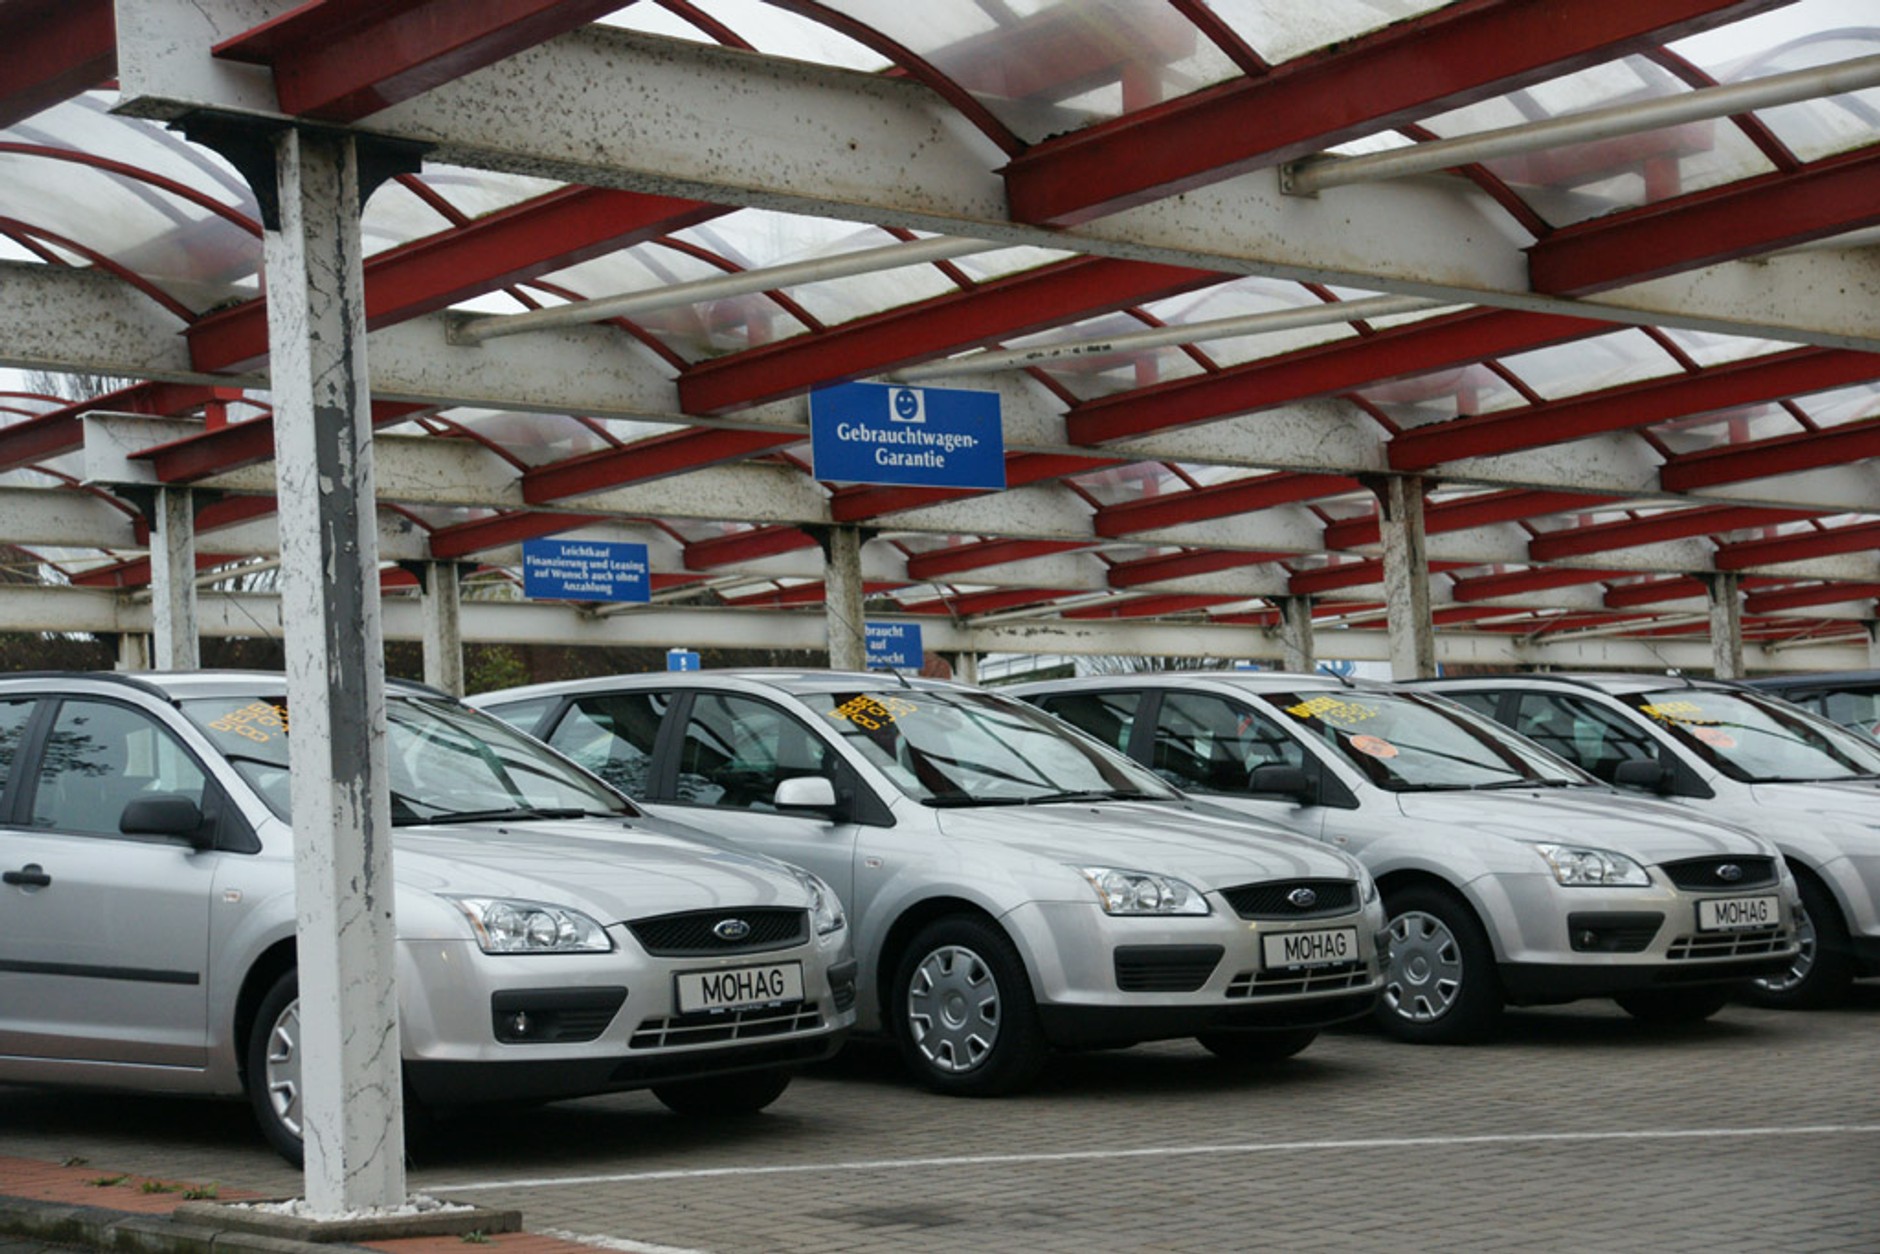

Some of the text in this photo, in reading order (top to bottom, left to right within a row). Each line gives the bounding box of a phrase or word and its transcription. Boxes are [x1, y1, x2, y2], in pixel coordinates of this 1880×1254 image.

[837, 422, 979, 453] Gebrauchtwagen-
[875, 447, 946, 468] Garantie
[561, 545, 610, 558] Leichtkauf
[526, 555, 646, 574] Finanzierung und Leasing
[534, 568, 640, 583] auf Wunsch auch ohne
[563, 581, 613, 596] Anzahlung
[870, 638, 887, 651] auf
[1714, 900, 1768, 925] MOHAG
[1284, 932, 1347, 962] MOHAG
[701, 968, 784, 1005] MOHAG
